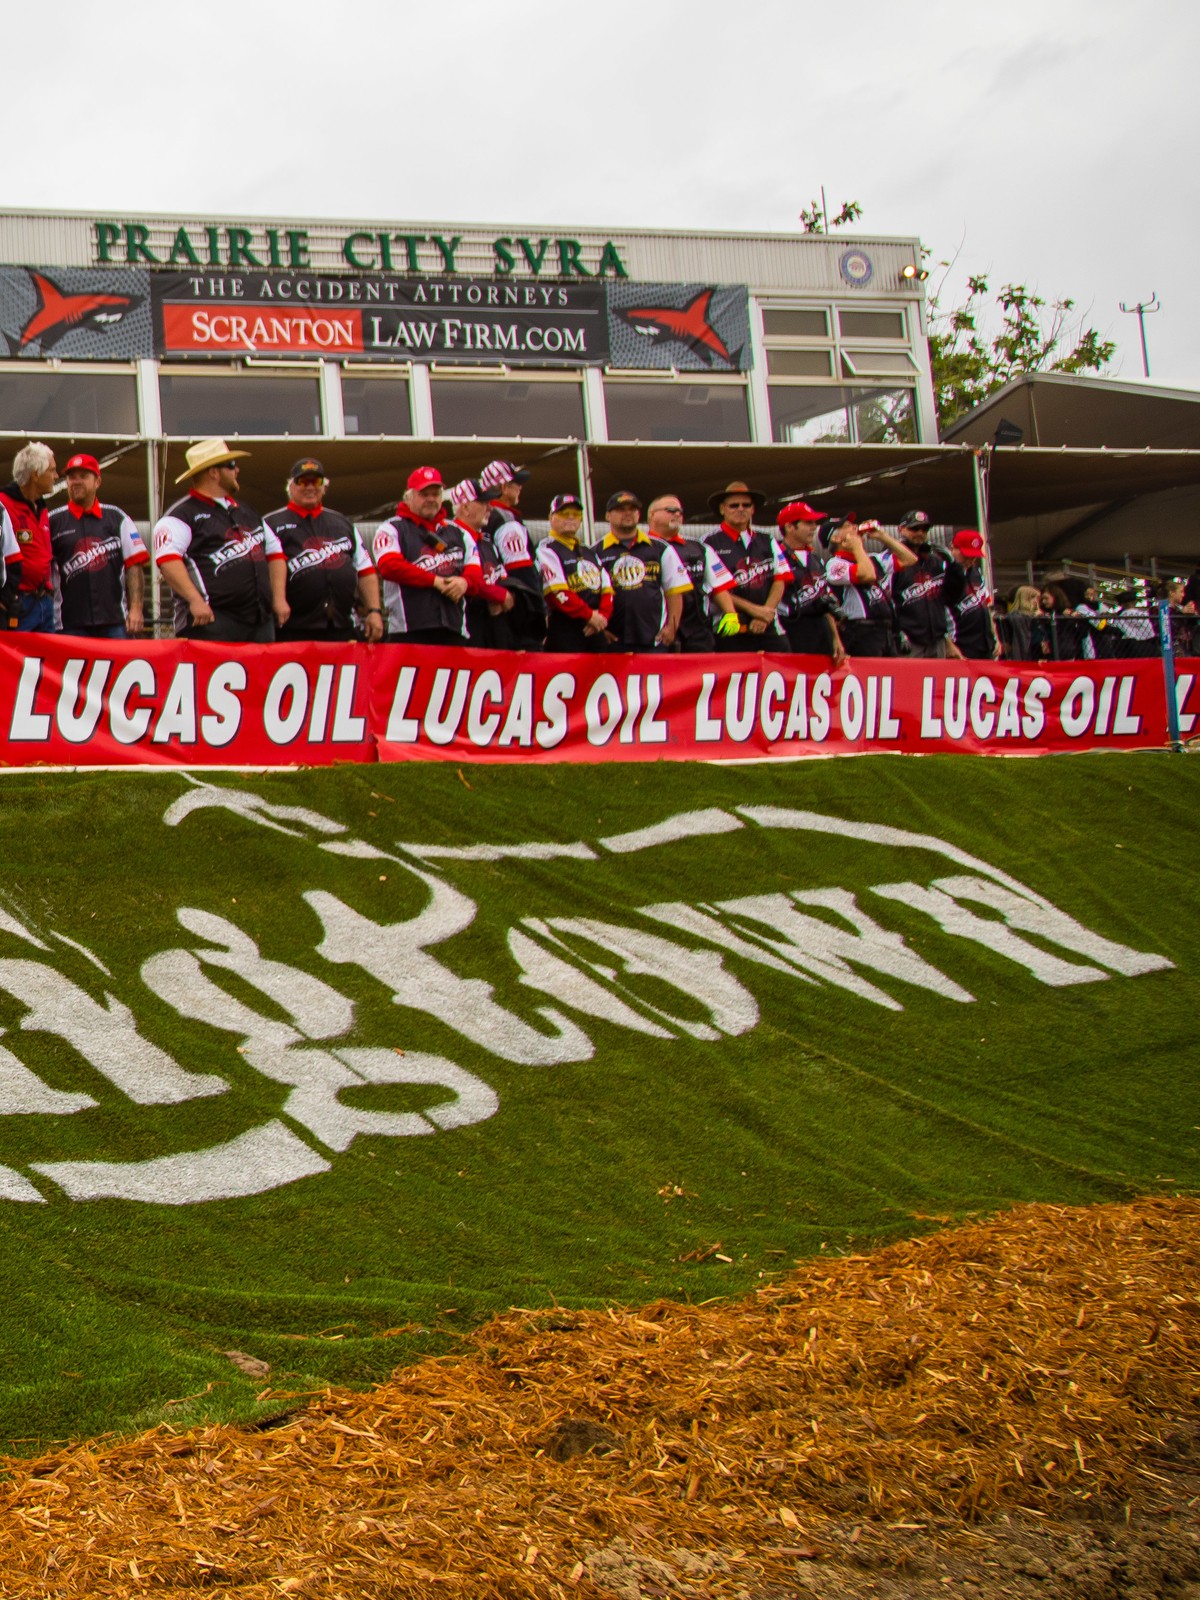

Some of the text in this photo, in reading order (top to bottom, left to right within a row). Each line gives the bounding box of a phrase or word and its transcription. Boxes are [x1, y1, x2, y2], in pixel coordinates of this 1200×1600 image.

[94, 222, 629, 279] PRAIRIE CITY SVRA
[189, 276, 569, 306] THE ACCIDENT ATTORNEYS
[191, 310, 587, 351] SCRANTON LAWFIRM.COM
[8, 656, 367, 746] LUCAS OIL
[384, 665, 668, 748] LUCAS OIL
[695, 671, 900, 743] LUCAS OIL
[919, 675, 1141, 740] LUCAS OIL
